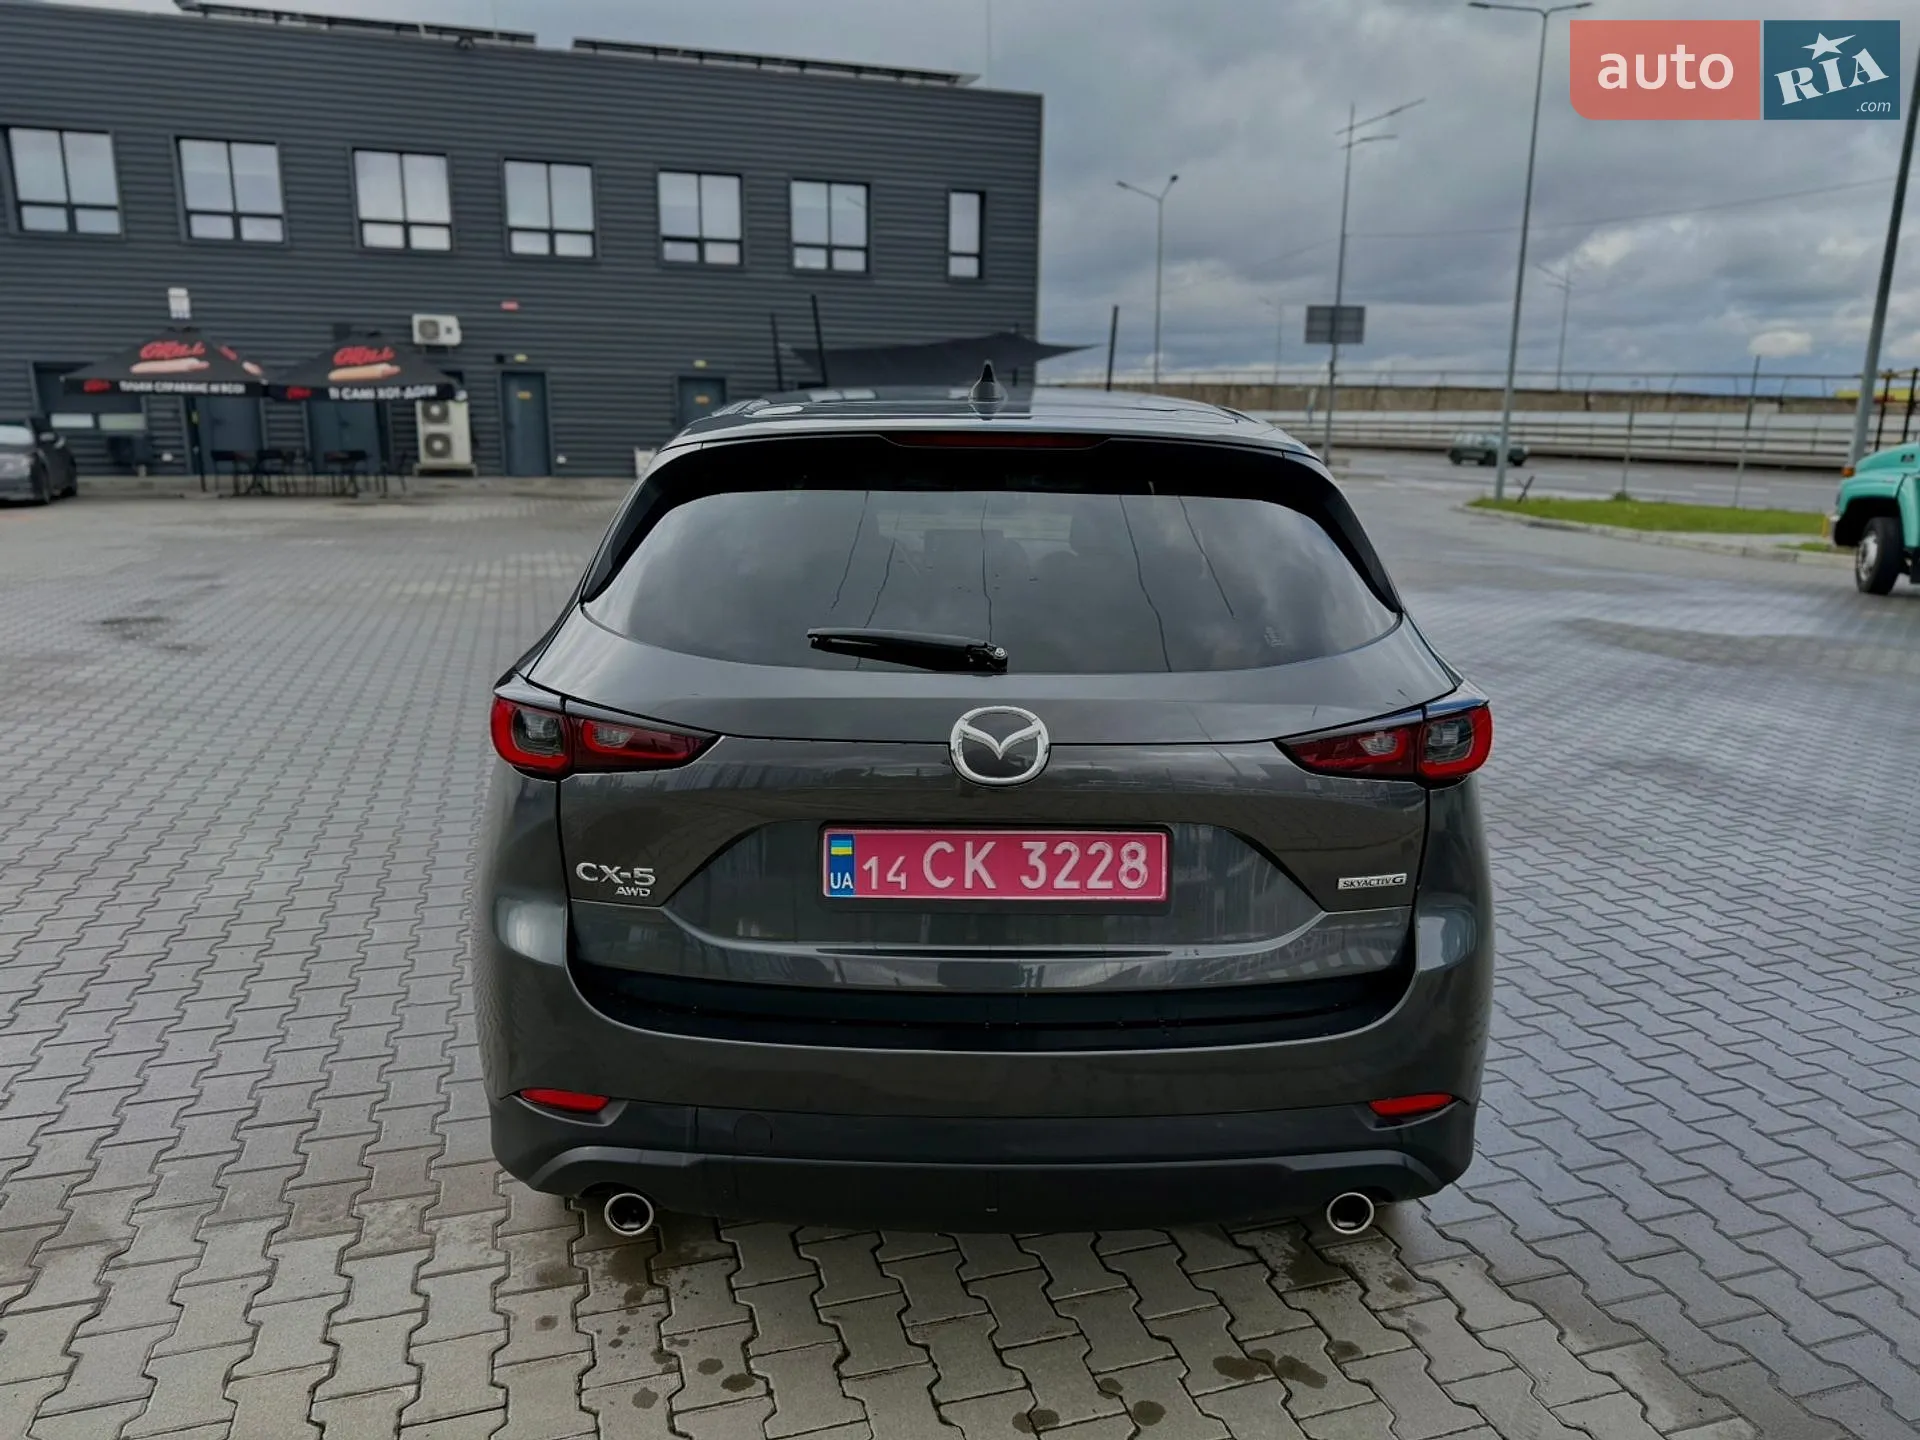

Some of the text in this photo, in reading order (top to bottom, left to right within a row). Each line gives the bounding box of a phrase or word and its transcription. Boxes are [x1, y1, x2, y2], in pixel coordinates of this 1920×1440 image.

[575, 862, 656, 886] CX-5
[861, 841, 1149, 890] 14 CK 3228
[615, 886, 651, 897] AWD
[829, 872, 854, 890] UA
